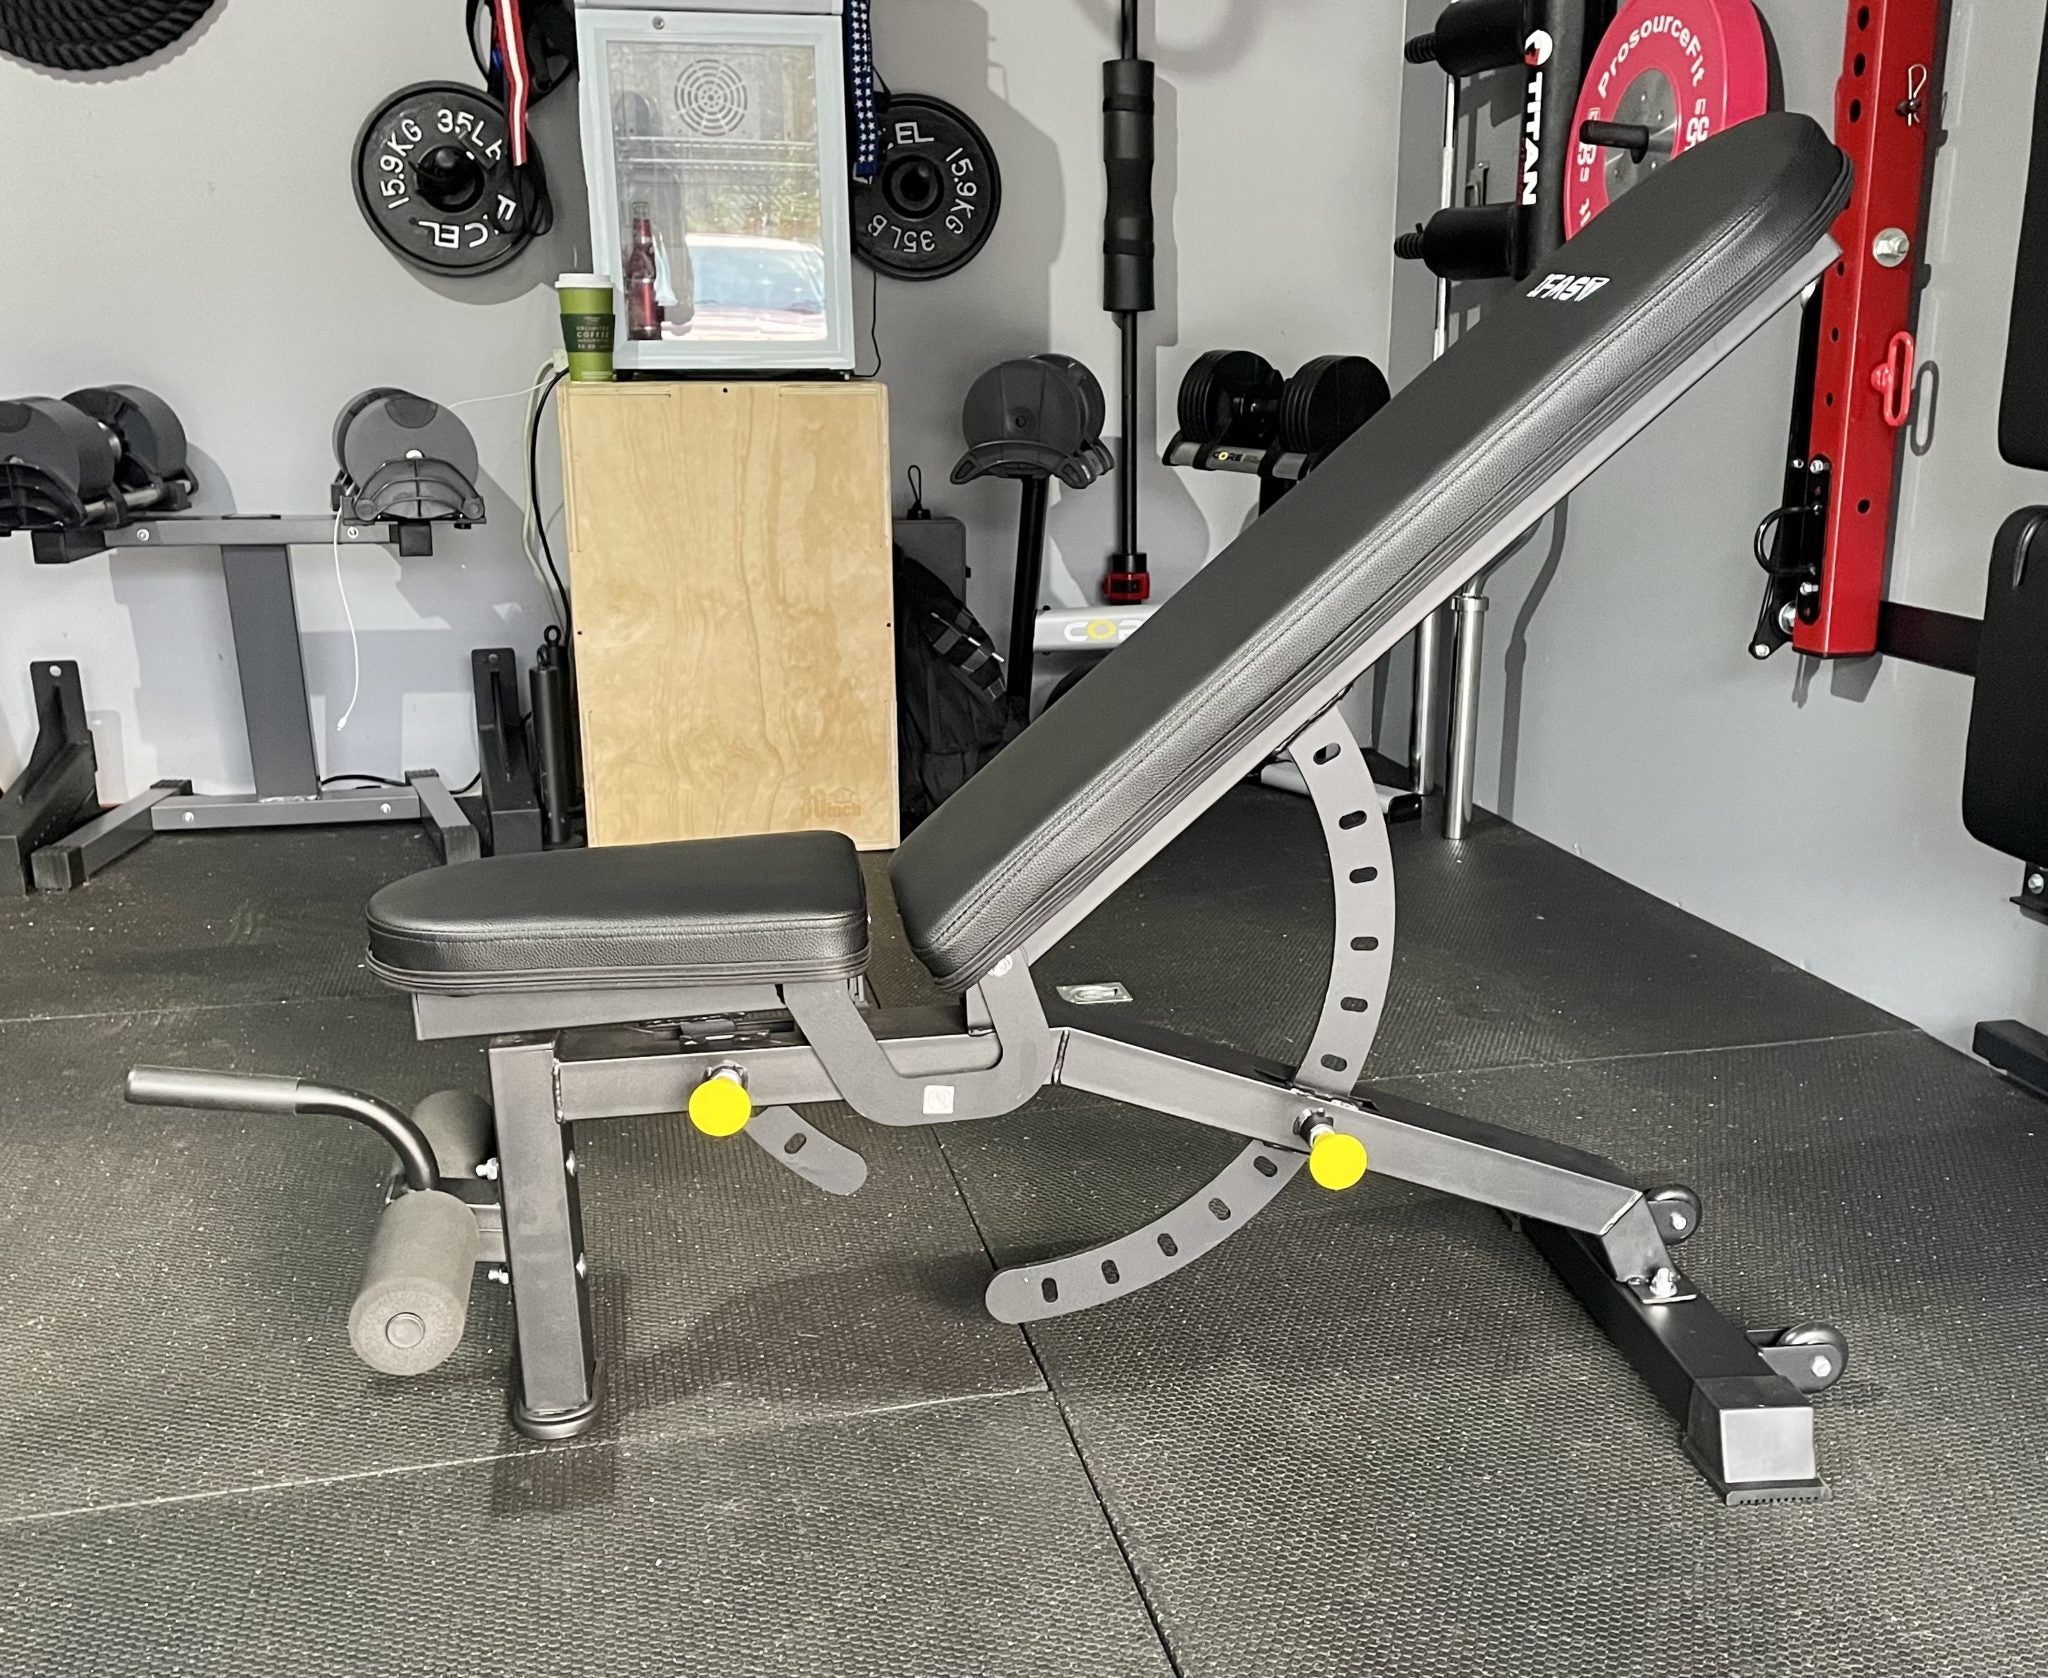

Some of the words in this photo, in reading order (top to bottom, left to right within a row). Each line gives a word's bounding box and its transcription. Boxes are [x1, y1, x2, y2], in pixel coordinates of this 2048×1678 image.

[1598, 15, 1705, 99] ProsourceFit
[380, 119, 423, 209] 15.9KG
[1521, 71, 1543, 206] TITAN
[945, 147, 977, 234] 15.9KG
[1212, 451, 1242, 463] CORE
